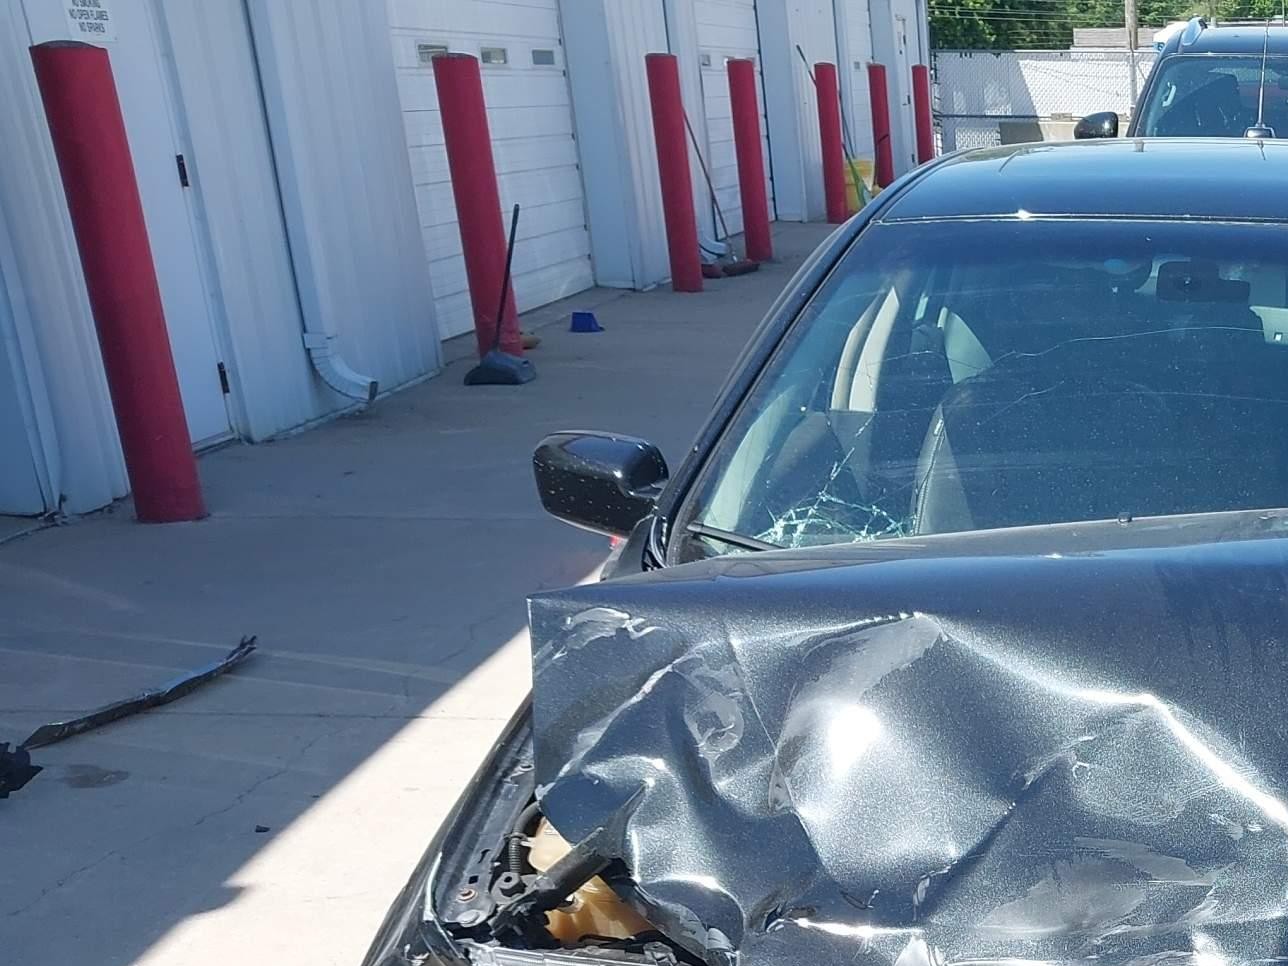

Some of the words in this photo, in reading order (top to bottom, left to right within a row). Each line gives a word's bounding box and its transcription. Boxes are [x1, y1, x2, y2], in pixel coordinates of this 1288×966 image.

[69, 9, 77, 19] NO
[77, 9, 90, 20] OPEN
[79, 21, 87, 32] NO
